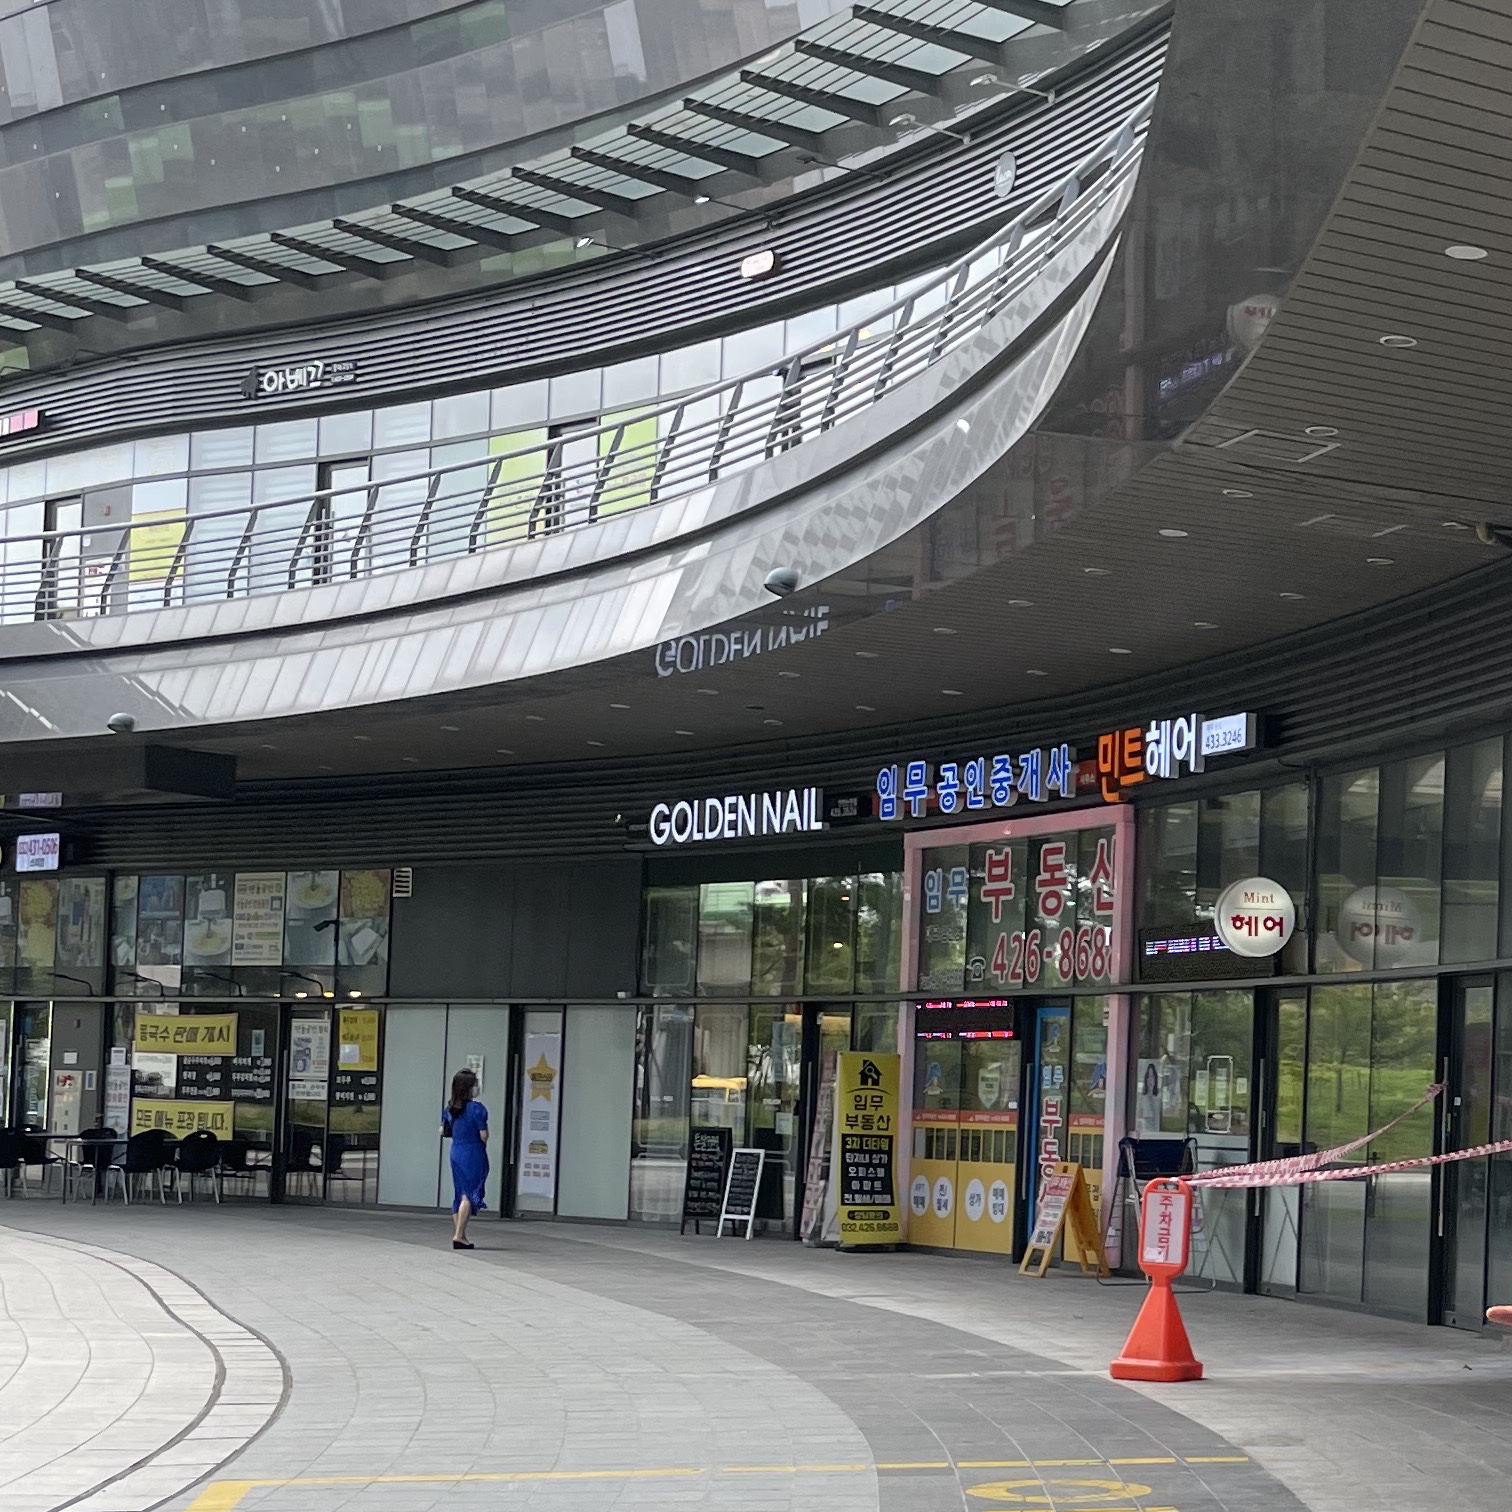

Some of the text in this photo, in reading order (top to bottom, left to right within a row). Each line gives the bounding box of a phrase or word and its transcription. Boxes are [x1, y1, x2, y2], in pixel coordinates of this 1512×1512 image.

[877, 761, 928, 821] 임무
[936, 743, 1073, 812] 공인중개사
[649, 788, 823, 846] GOLDEN NAIL
[925, 841, 1116, 923] 임무 부동산
[1243, 892, 1275, 904] Mint
[1231, 914, 1284, 938] 헤어
[991, 925, 1113, 983] 426-868
[201, 1024, 231, 1042] 개시
[1042, 1065, 1064, 1090] 임무
[854, 1094, 884, 1111] 임무
[845, 1113, 891, 1132] 부동산
